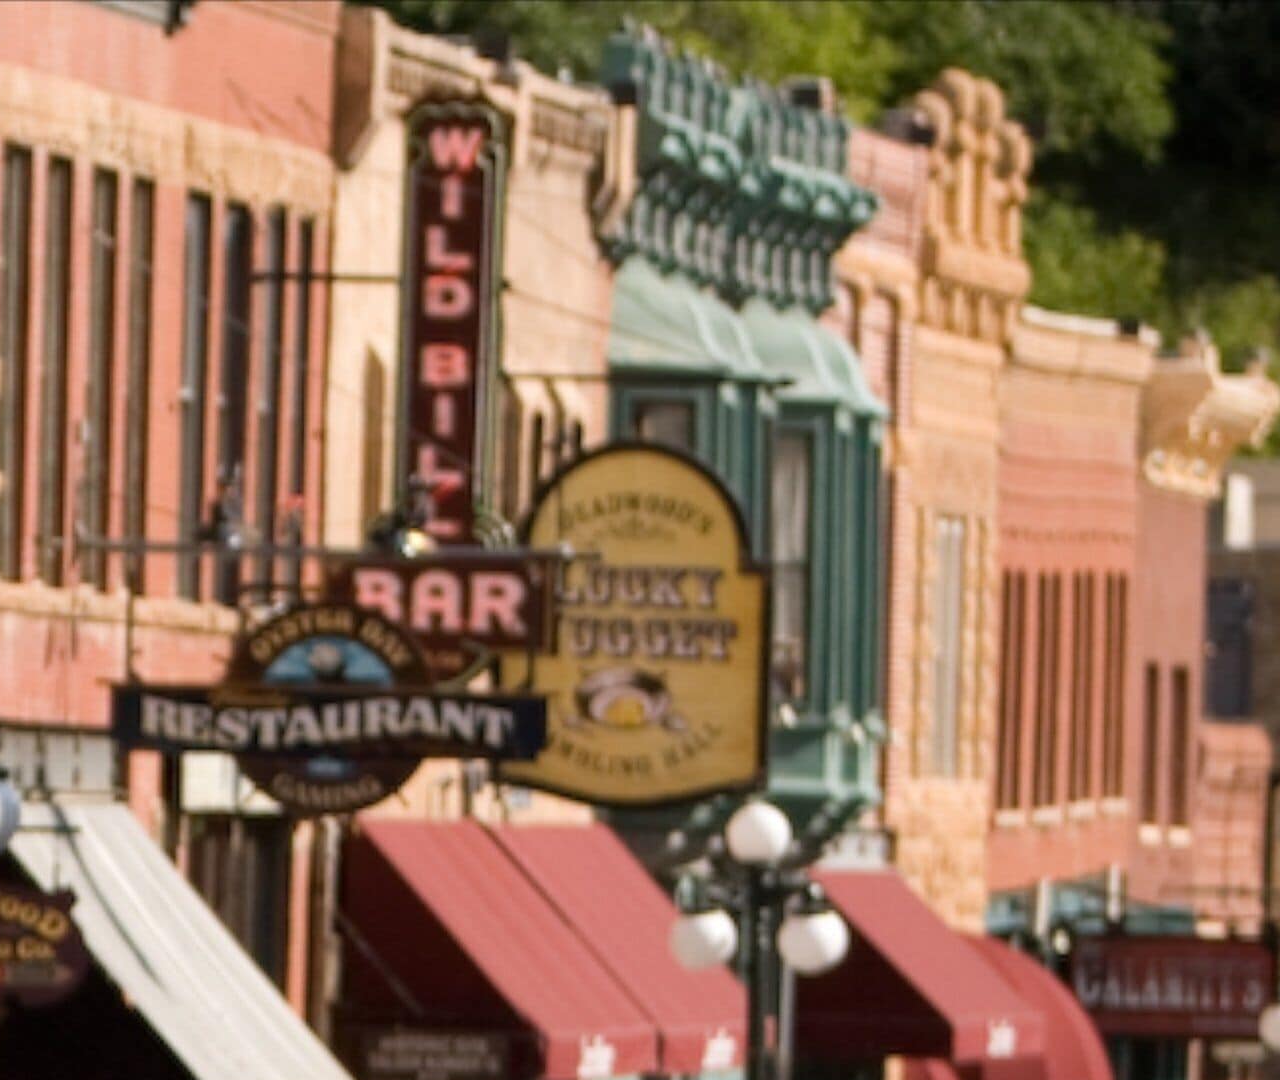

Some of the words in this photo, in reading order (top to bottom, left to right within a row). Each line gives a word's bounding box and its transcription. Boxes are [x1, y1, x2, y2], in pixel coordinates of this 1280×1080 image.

[423, 127, 483, 318] WILD
[353, 570, 527, 637] BAR
[566, 615, 739, 664] UGGET
[139, 695, 515, 750] RESTAURANT
